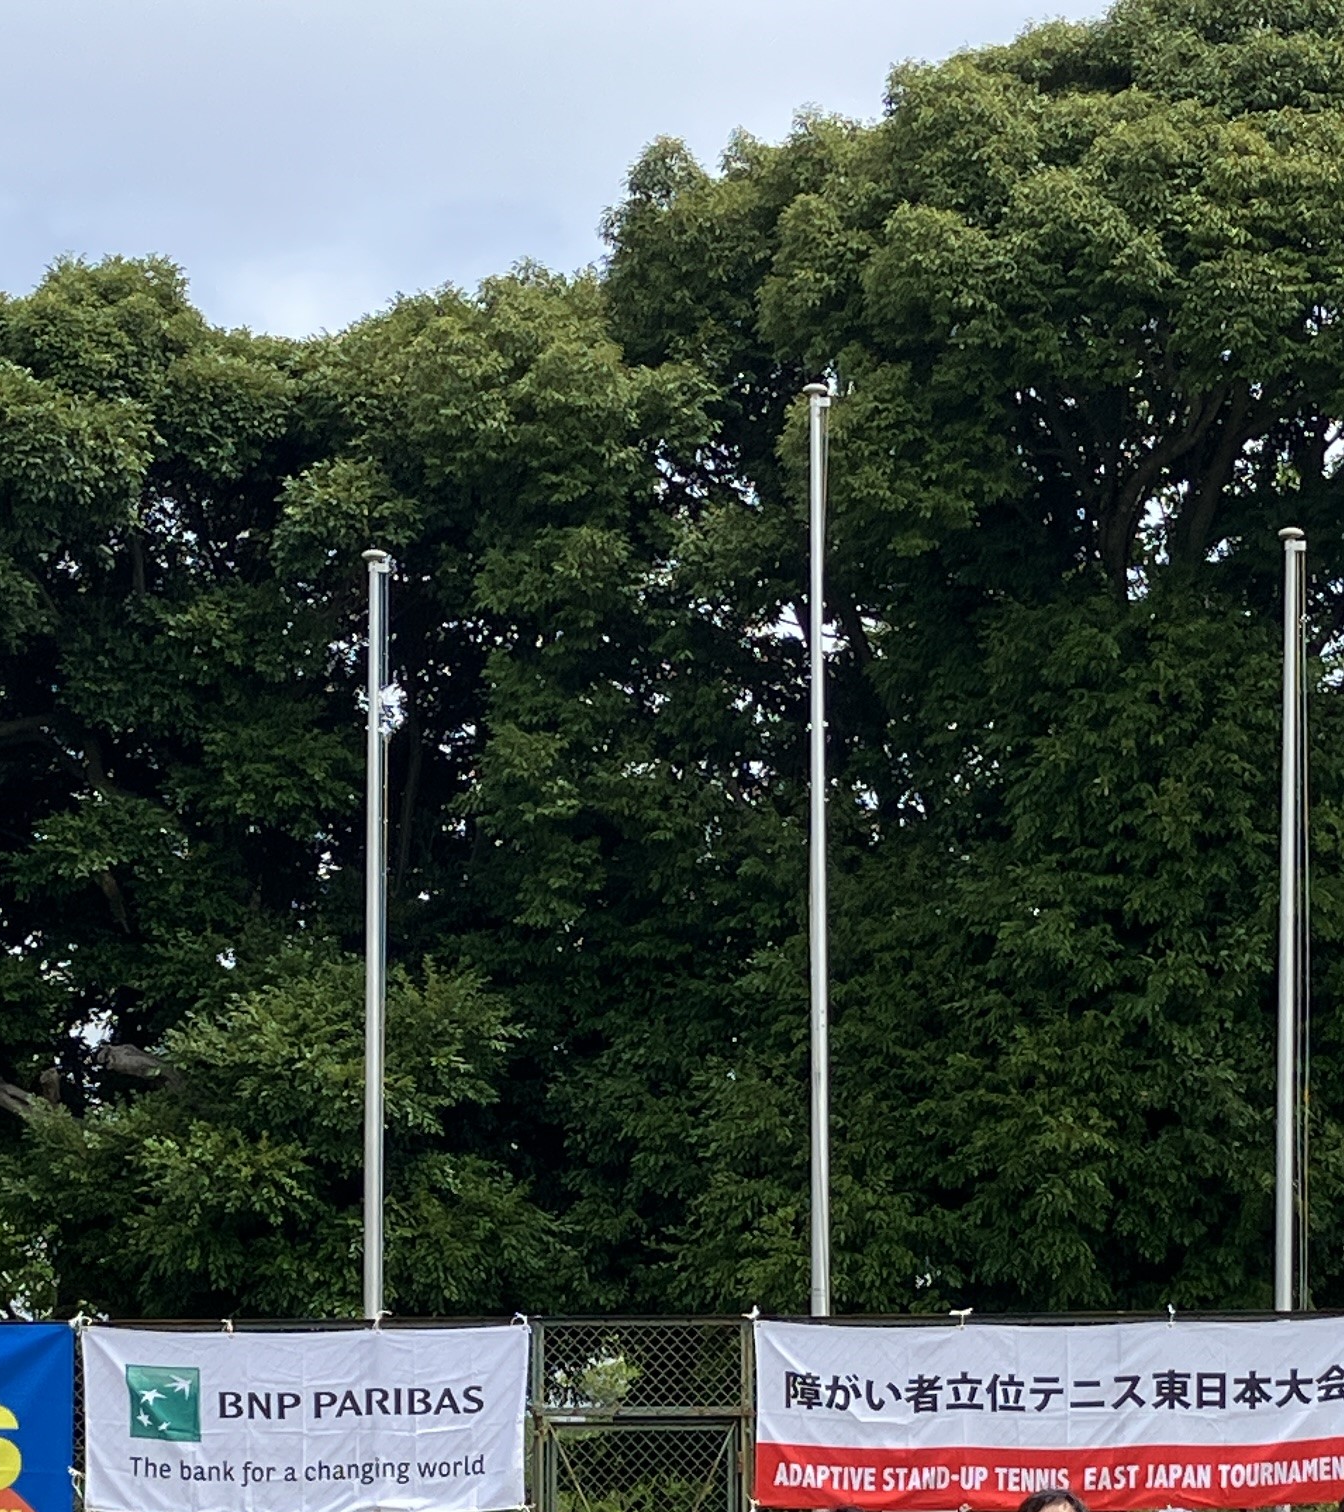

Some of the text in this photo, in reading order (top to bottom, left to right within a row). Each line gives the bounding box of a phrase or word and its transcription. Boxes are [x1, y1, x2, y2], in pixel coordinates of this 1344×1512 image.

[218, 1385, 485, 1420] BNP PARIBAS
[129, 1454, 485, 1486] The bank for a changing world
[773, 1462, 876, 1491] ADAPTIVE
[882, 1465, 989, 1492] STAND-UP
[994, 1466, 1069, 1492] TENNIS
[1084, 1463, 1137, 1490] EAST
[1145, 1461, 1212, 1489] JAPAN
